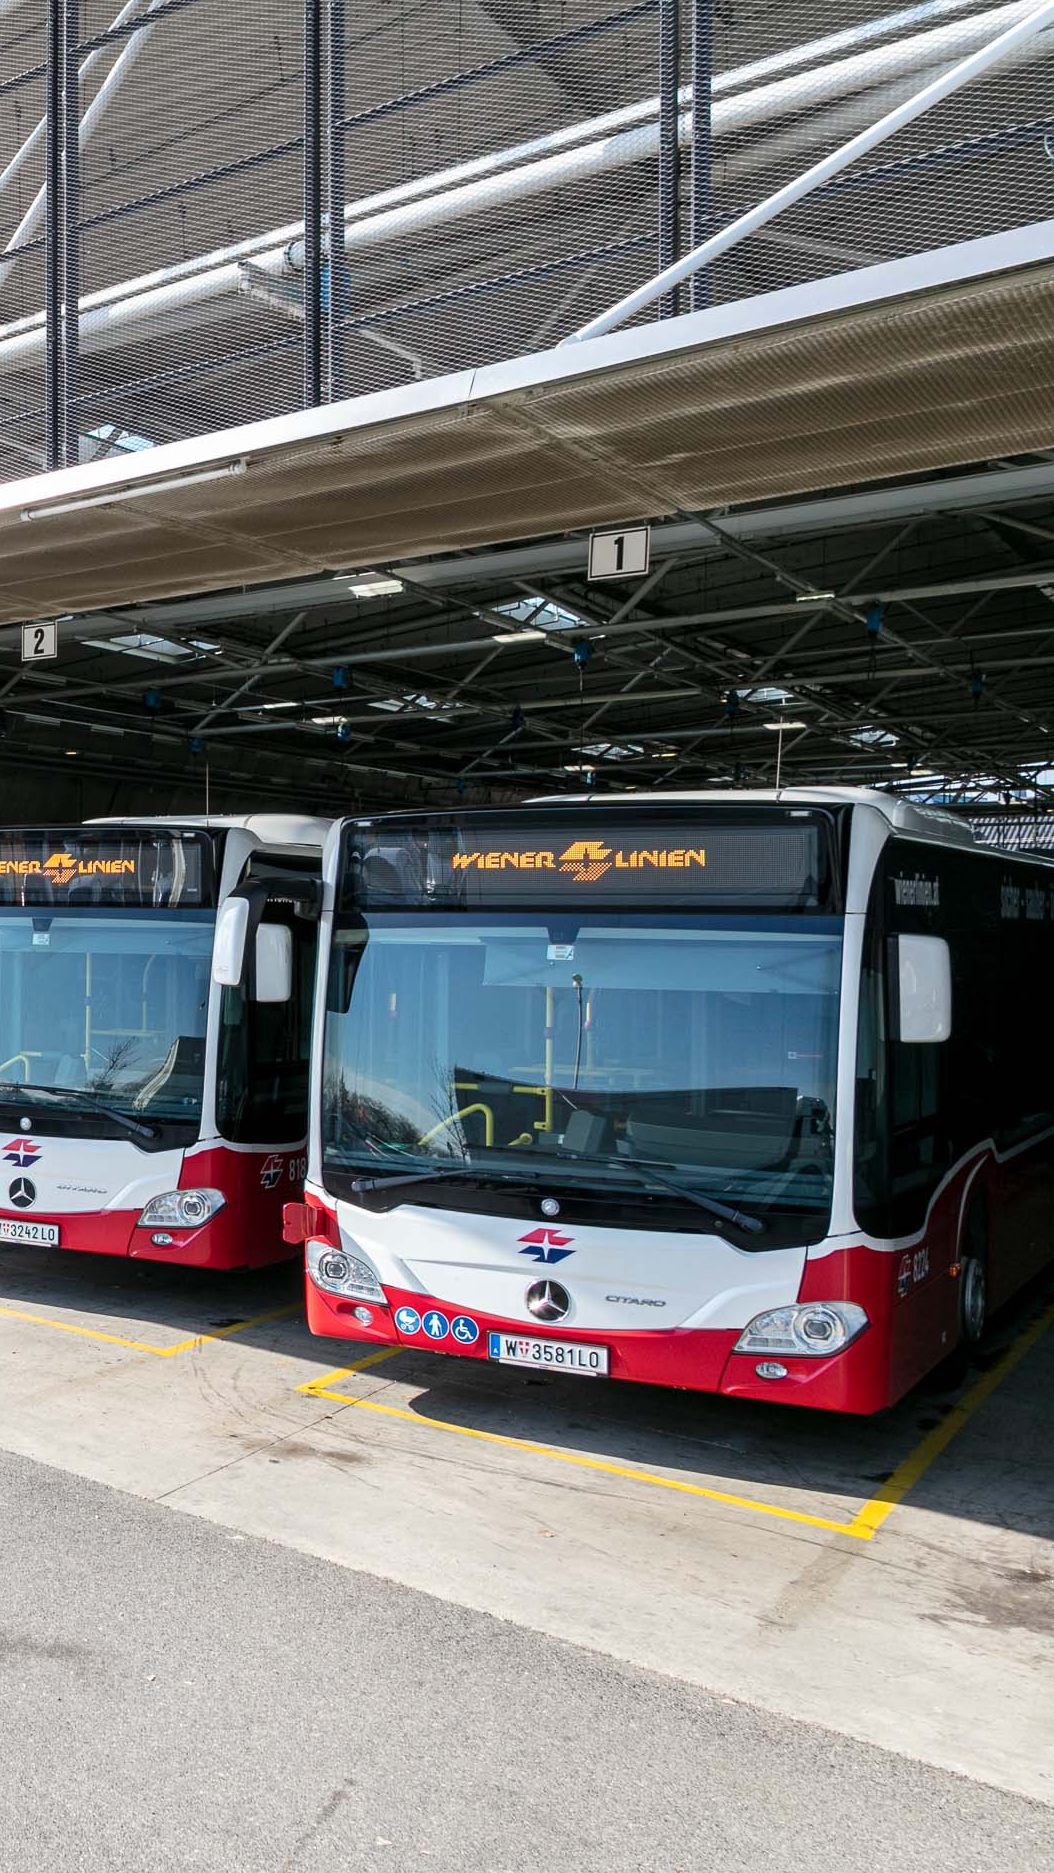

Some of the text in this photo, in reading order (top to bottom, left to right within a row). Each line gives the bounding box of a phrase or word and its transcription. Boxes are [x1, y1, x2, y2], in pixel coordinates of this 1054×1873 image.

[613, 536, 625, 571] 1
[33, 628, 45, 655] 2
[78, 859, 135, 874] LINIEN
[452, 849, 706, 869] WIENER LINIEN
[605, 1295, 667, 1308] CITARO
[505, 1339, 518, 1357] W
